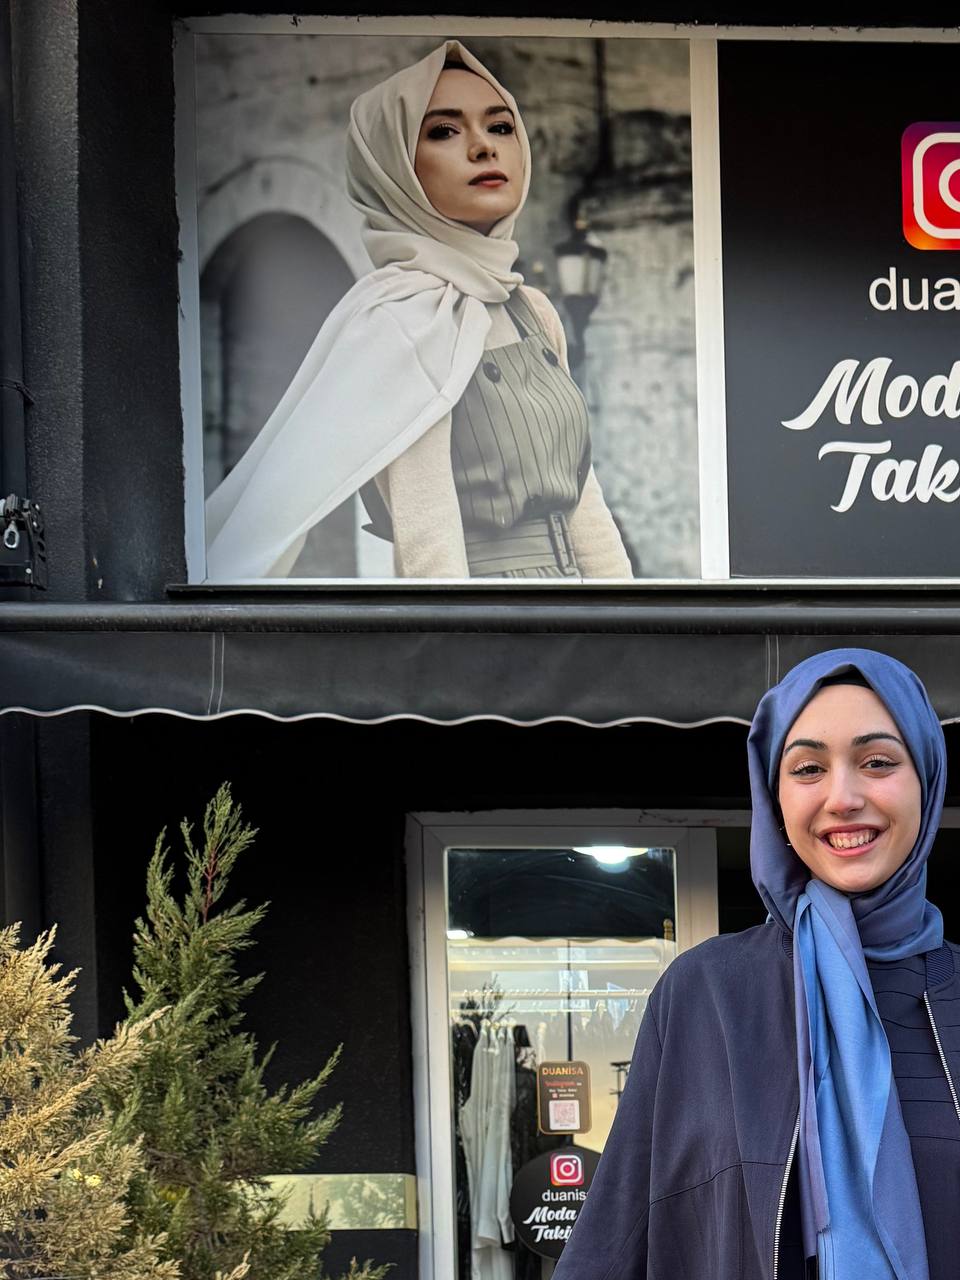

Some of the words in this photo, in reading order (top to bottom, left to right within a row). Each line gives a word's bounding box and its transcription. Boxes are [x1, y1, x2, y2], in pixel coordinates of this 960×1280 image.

[542, 1188, 588, 1201] duanis
[522, 1206, 577, 1224] Moda
[531, 1225, 573, 1243] Taki
